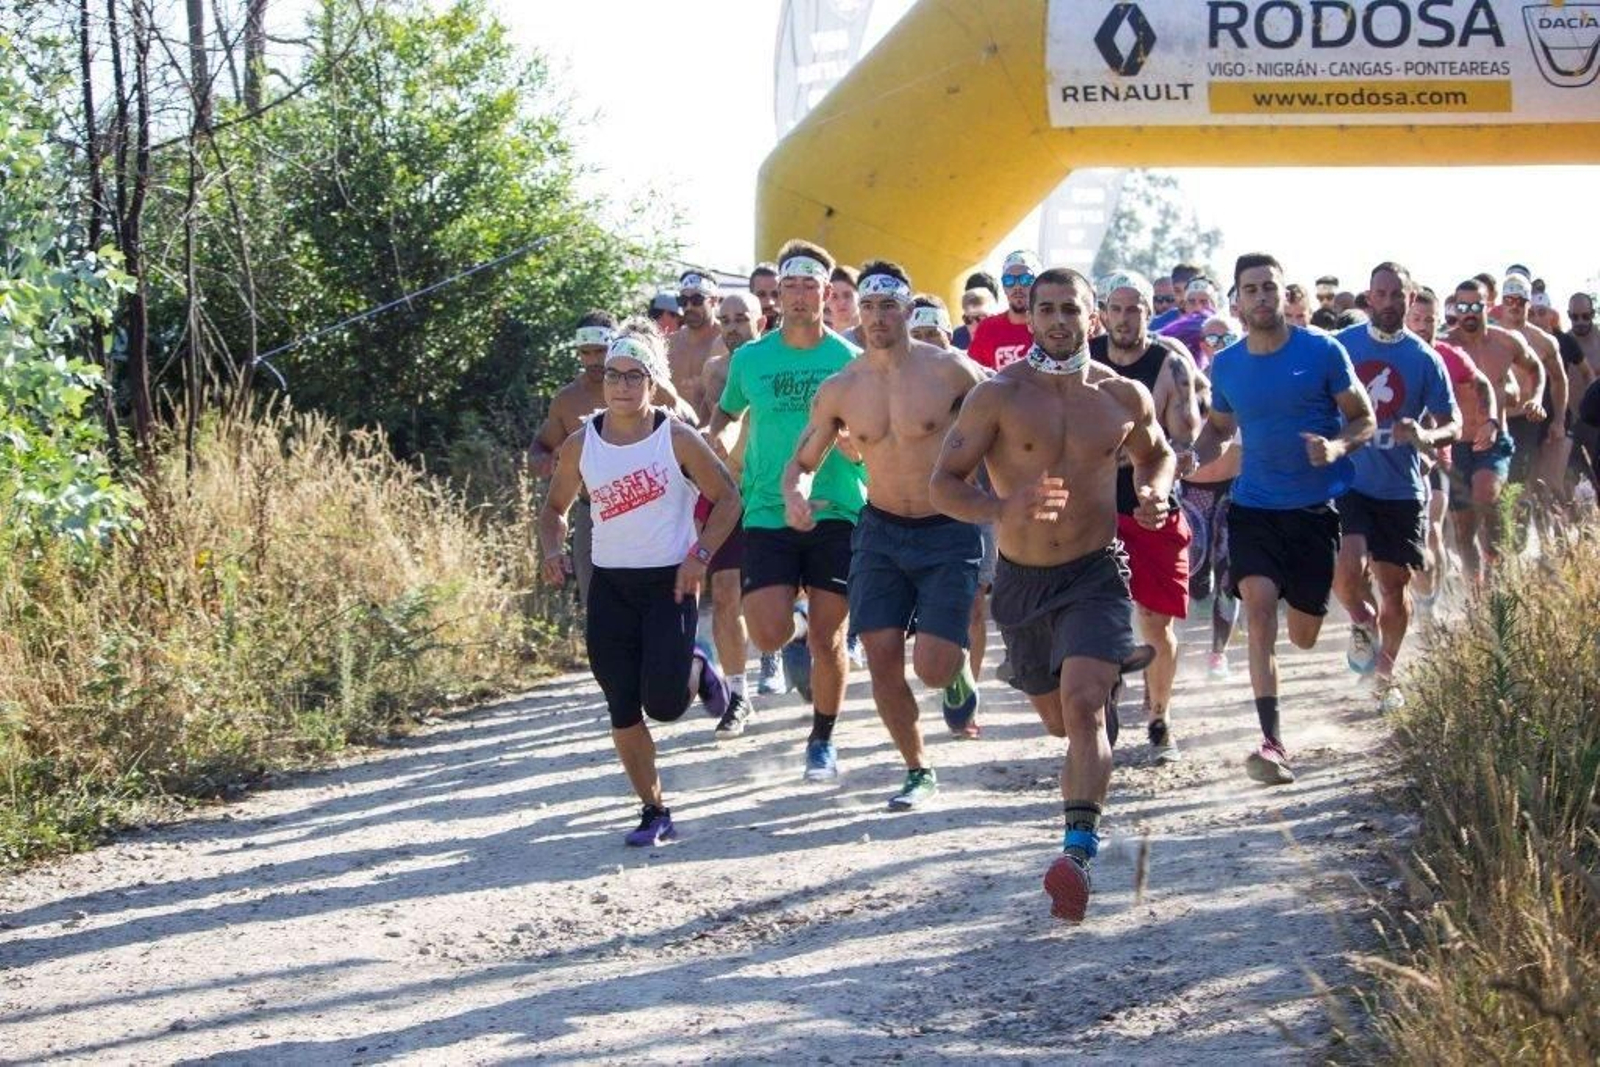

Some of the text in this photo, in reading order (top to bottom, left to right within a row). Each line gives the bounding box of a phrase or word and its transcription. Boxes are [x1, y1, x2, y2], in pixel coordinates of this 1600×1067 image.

[1207, 0, 1505, 49] RODOSA
[1538, 17, 1599, 29] DACIA
[1207, 58, 1510, 77] VIGO NIGRÁN CANGAS PONTEAREAS
[1061, 83, 1194, 103] RENAULT
[1252, 87, 1468, 106] www.rodosa.com
